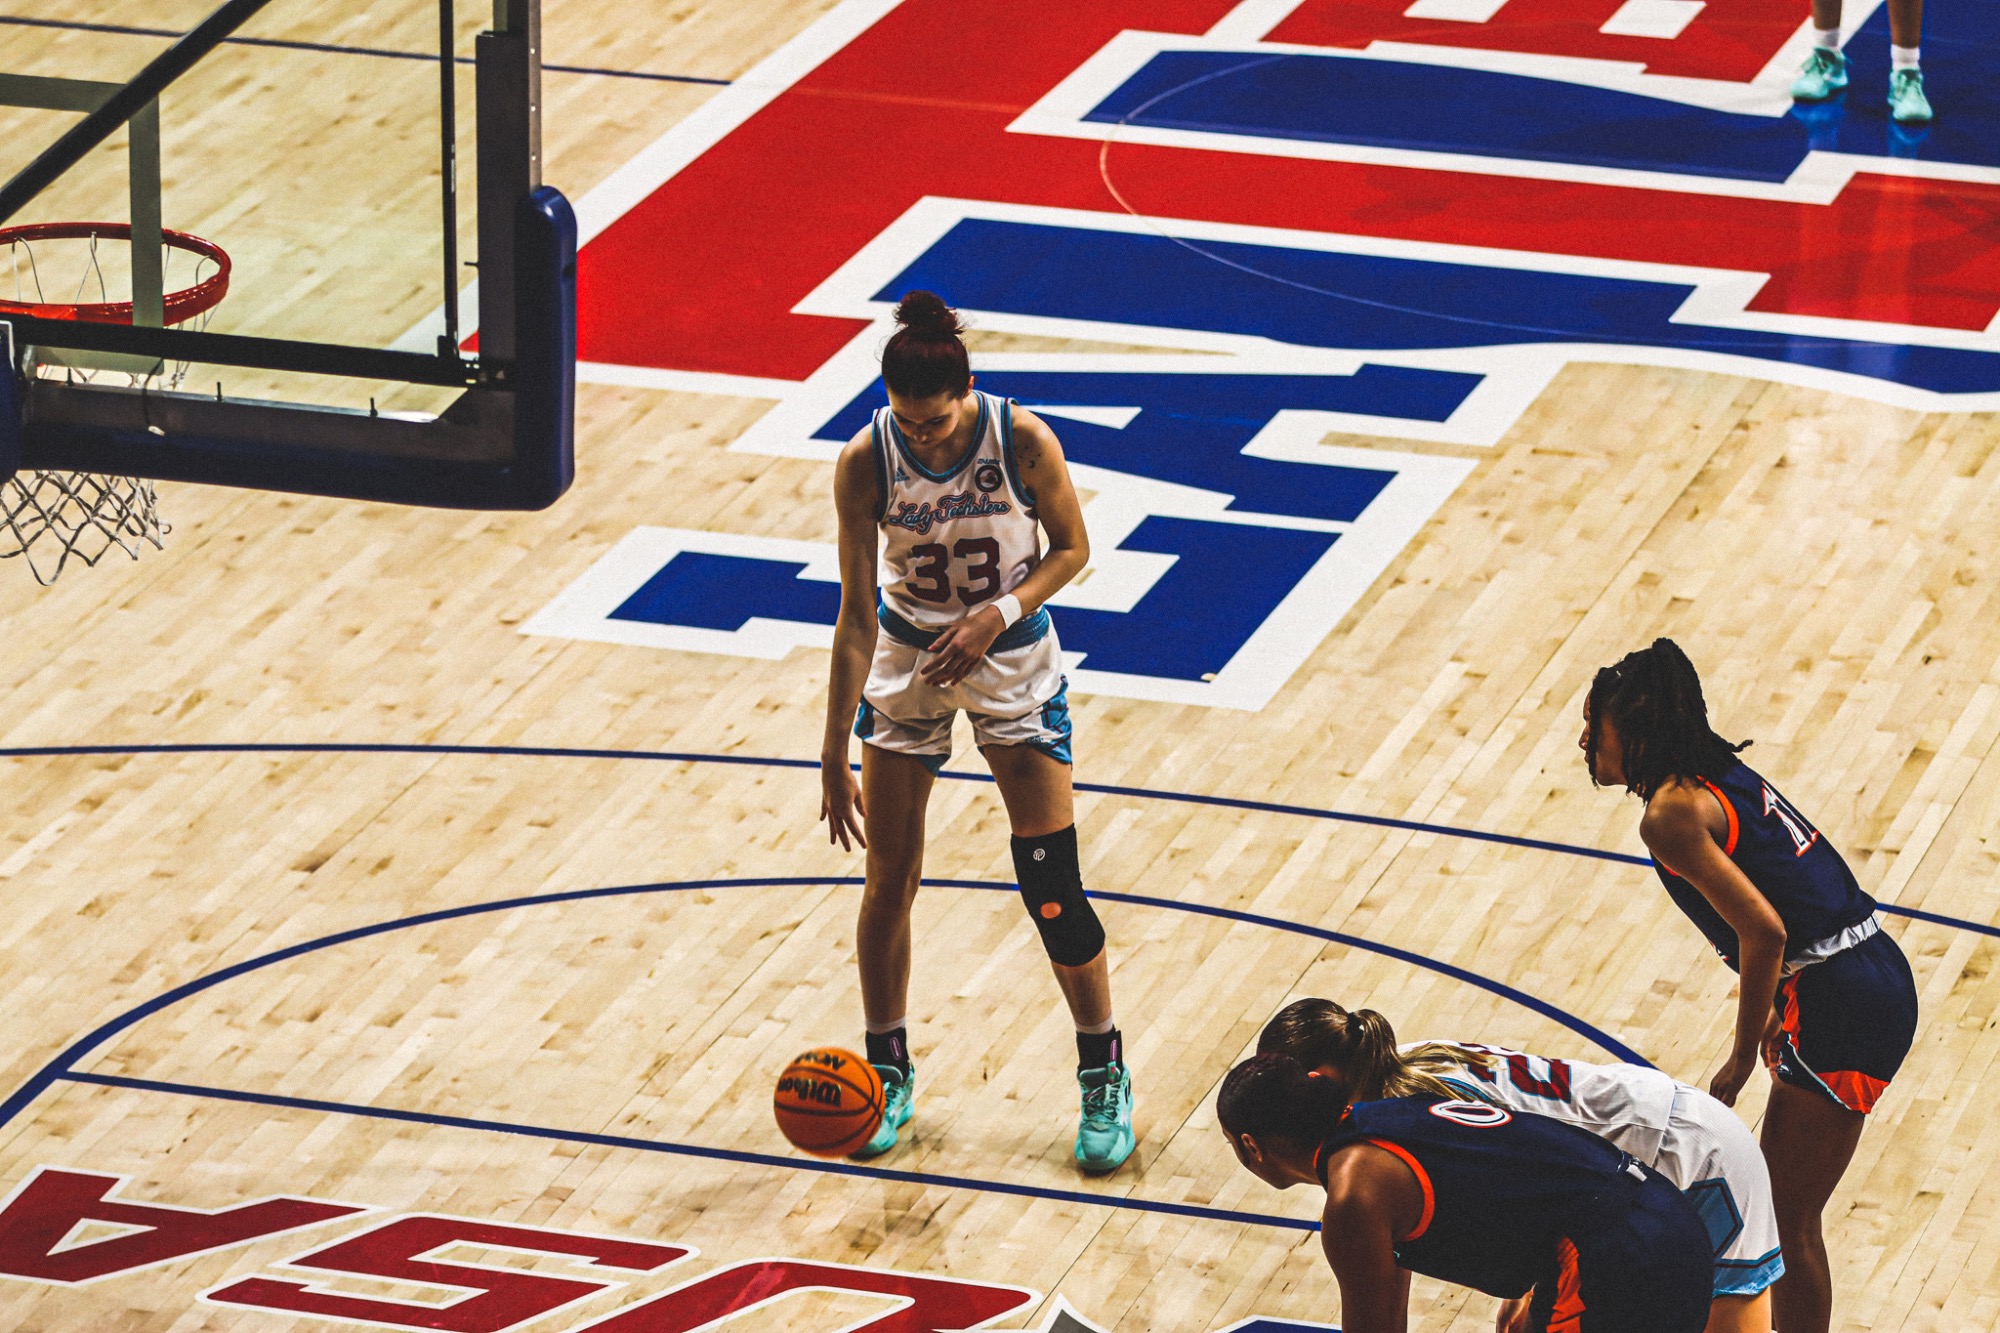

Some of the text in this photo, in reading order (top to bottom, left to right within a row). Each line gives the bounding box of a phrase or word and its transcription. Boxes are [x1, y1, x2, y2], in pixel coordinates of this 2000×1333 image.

[888, 490, 1011, 535] Lady Techsters
[904, 536, 1001, 607] 33
[1428, 1099, 1512, 1128] 0
